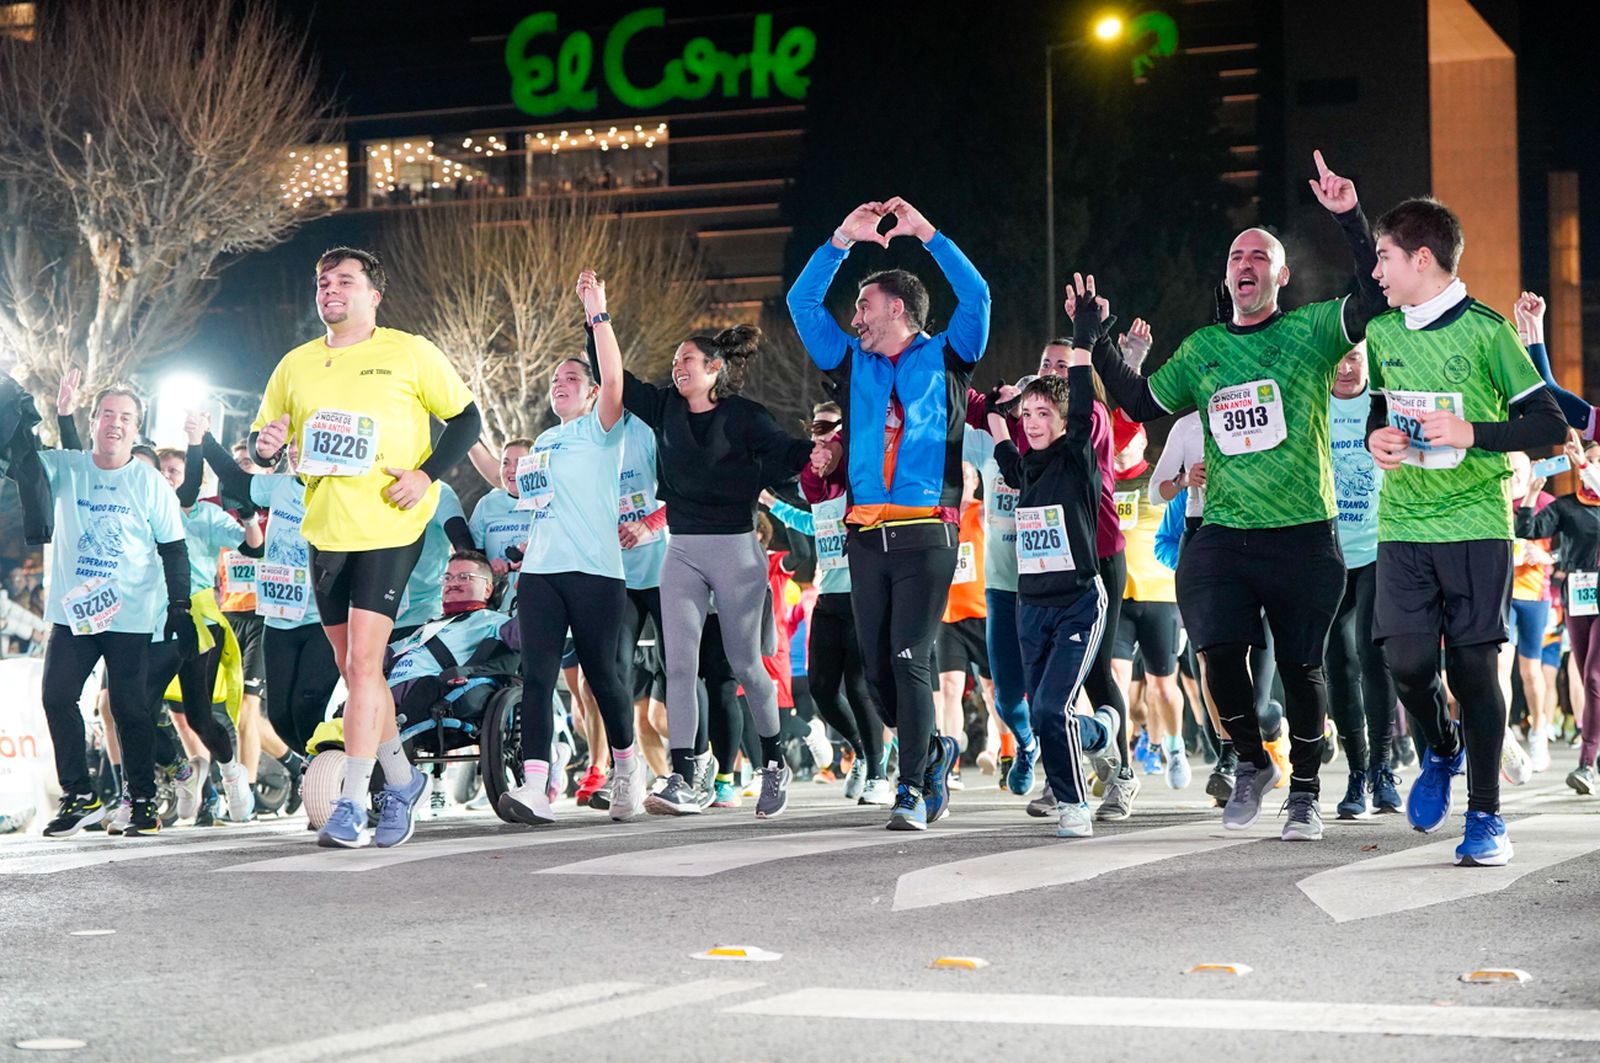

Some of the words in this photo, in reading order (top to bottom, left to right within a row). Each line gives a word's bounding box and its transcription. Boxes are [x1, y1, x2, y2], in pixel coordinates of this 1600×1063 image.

[505, 11, 598, 117] El
[603, 8, 817, 109] Corte
[1221, 391, 1242, 401] NOCHE
[1243, 390, 1251, 399] DE
[1417, 399, 1427, 407] DE
[1216, 402, 1229, 412] SAN
[312, 421, 327, 430] SAN
[321, 414, 343, 424] NOCHE
[343, 417, 352, 425] DE
[1223, 406, 1268, 431] 3913
[1393, 414, 1431, 442] 132
[312, 431, 368, 460] 13226
[520, 471, 547, 492] 13226
[1021, 528, 1061, 551] 13226
[78, 556, 118, 569] SUPERANDO
[261, 581, 303, 602] 13226
[72, 588, 118, 620] 13226
